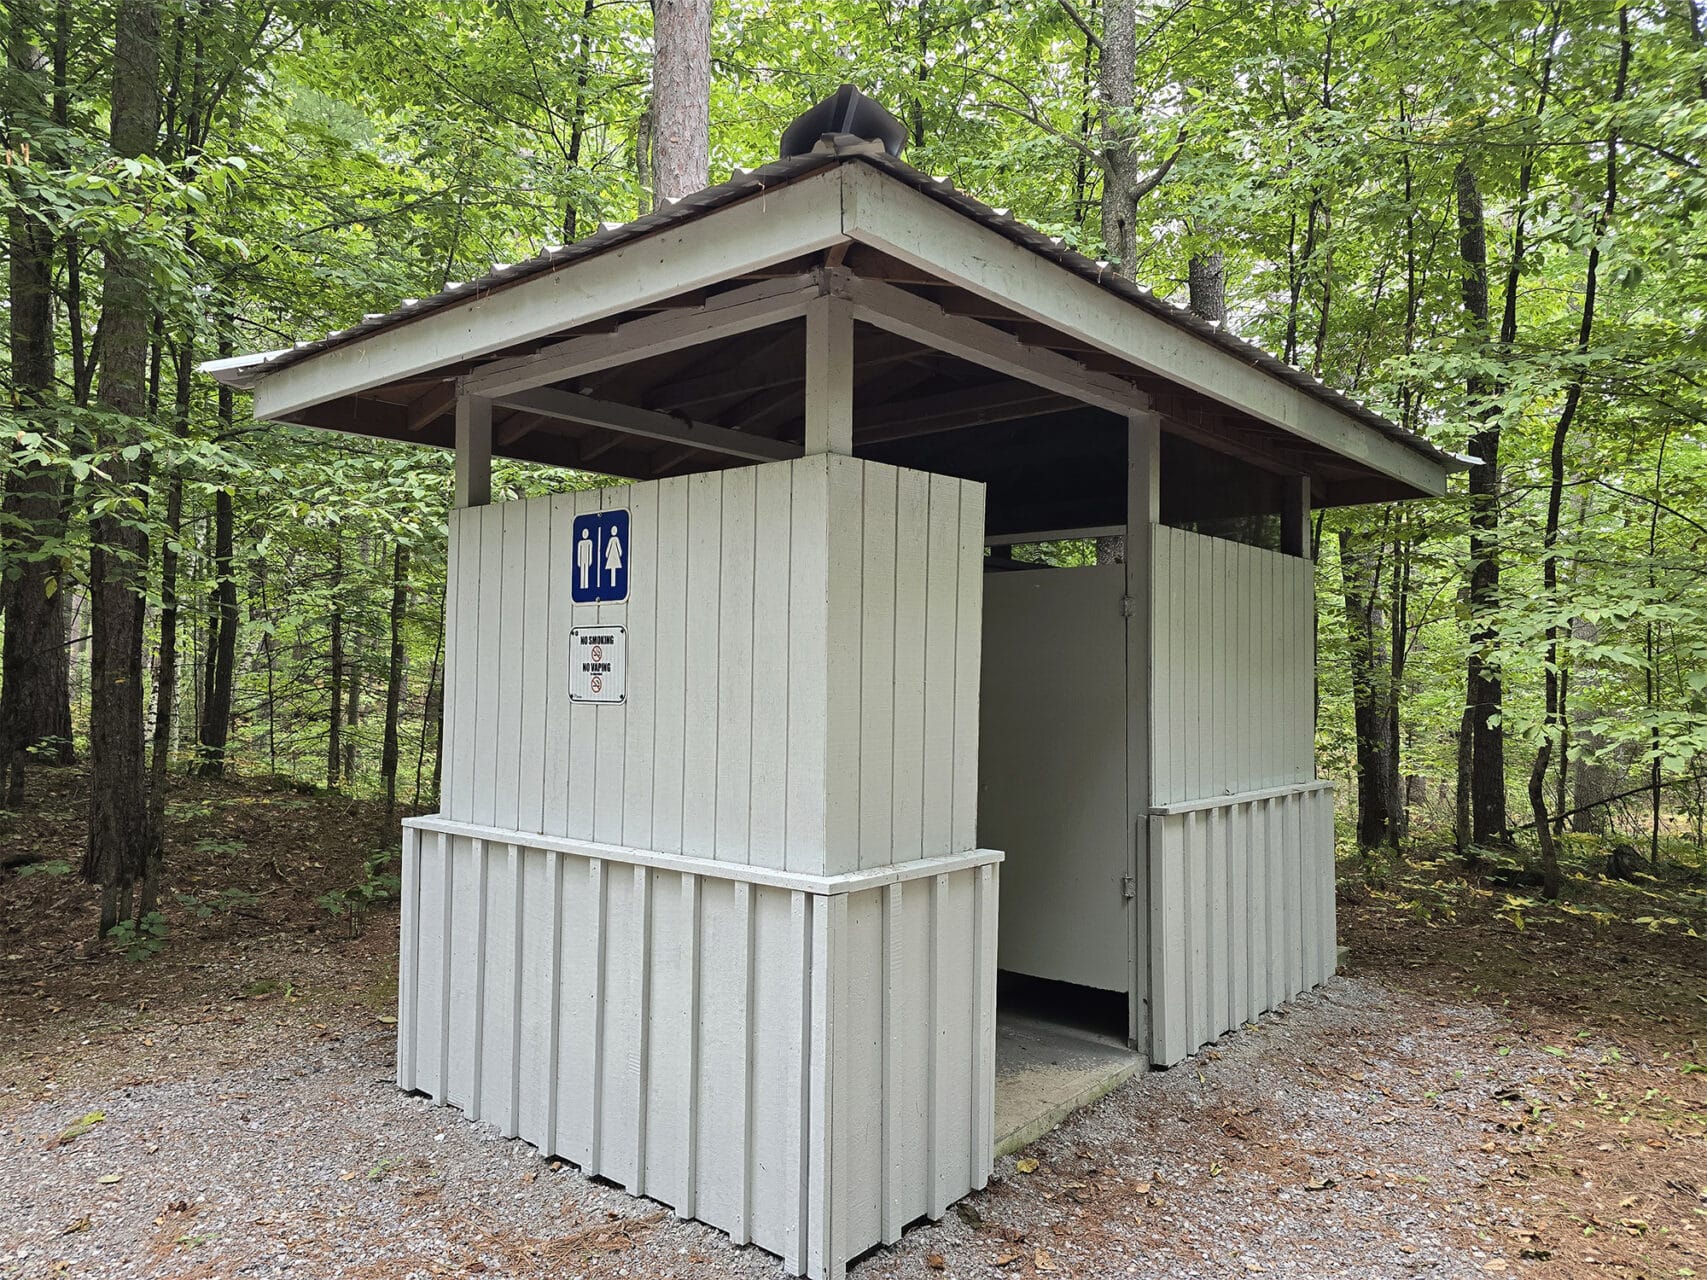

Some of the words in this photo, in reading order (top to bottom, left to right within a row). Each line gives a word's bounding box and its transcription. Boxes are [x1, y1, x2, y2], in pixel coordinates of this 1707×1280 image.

[580, 635, 588, 645] NO
[589, 635, 614, 645] SMOKING
[582, 663, 590, 672] NO
[591, 663, 611, 672] VAPING
